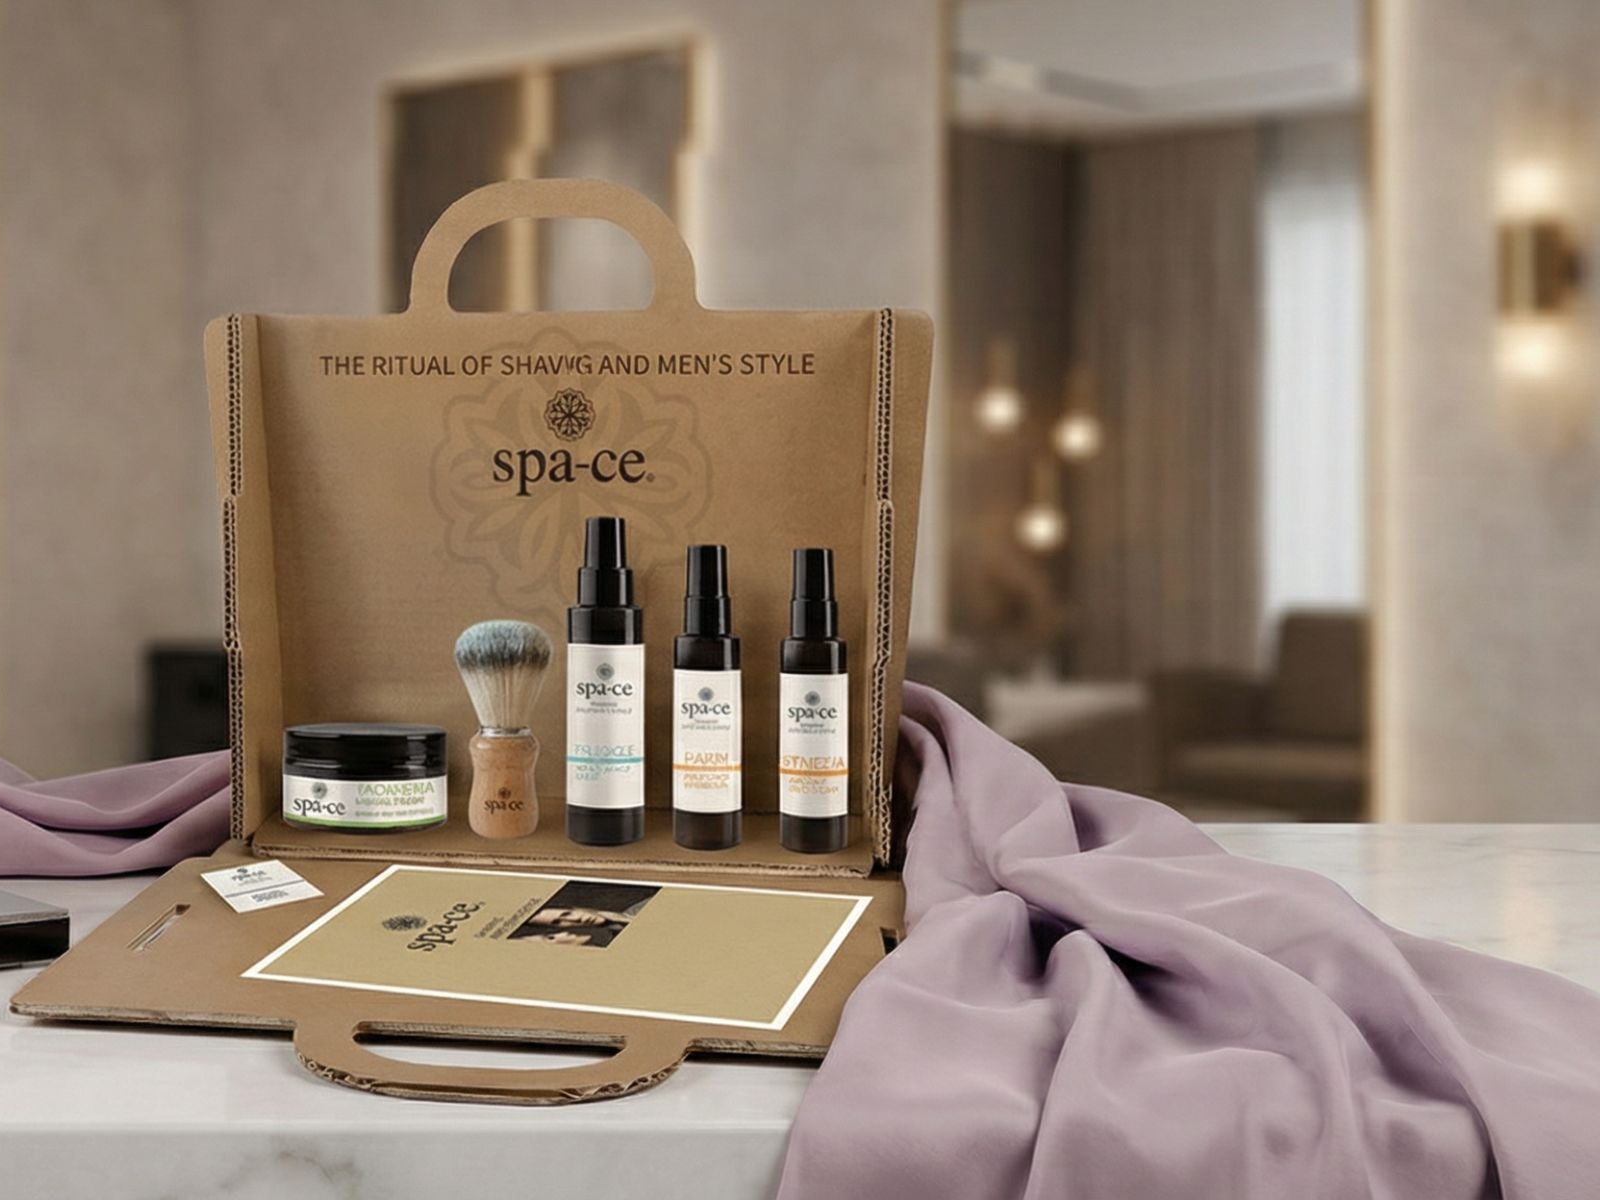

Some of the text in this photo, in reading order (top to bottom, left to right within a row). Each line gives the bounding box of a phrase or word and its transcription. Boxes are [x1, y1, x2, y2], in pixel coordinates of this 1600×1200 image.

[320, 355, 365, 375] THE
[373, 355, 455, 376] RITUAL
[462, 355, 492, 376] OF
[598, 354, 649, 375] AND
[658, 353, 732, 375] MEN'S
[740, 353, 815, 375] STYLE
